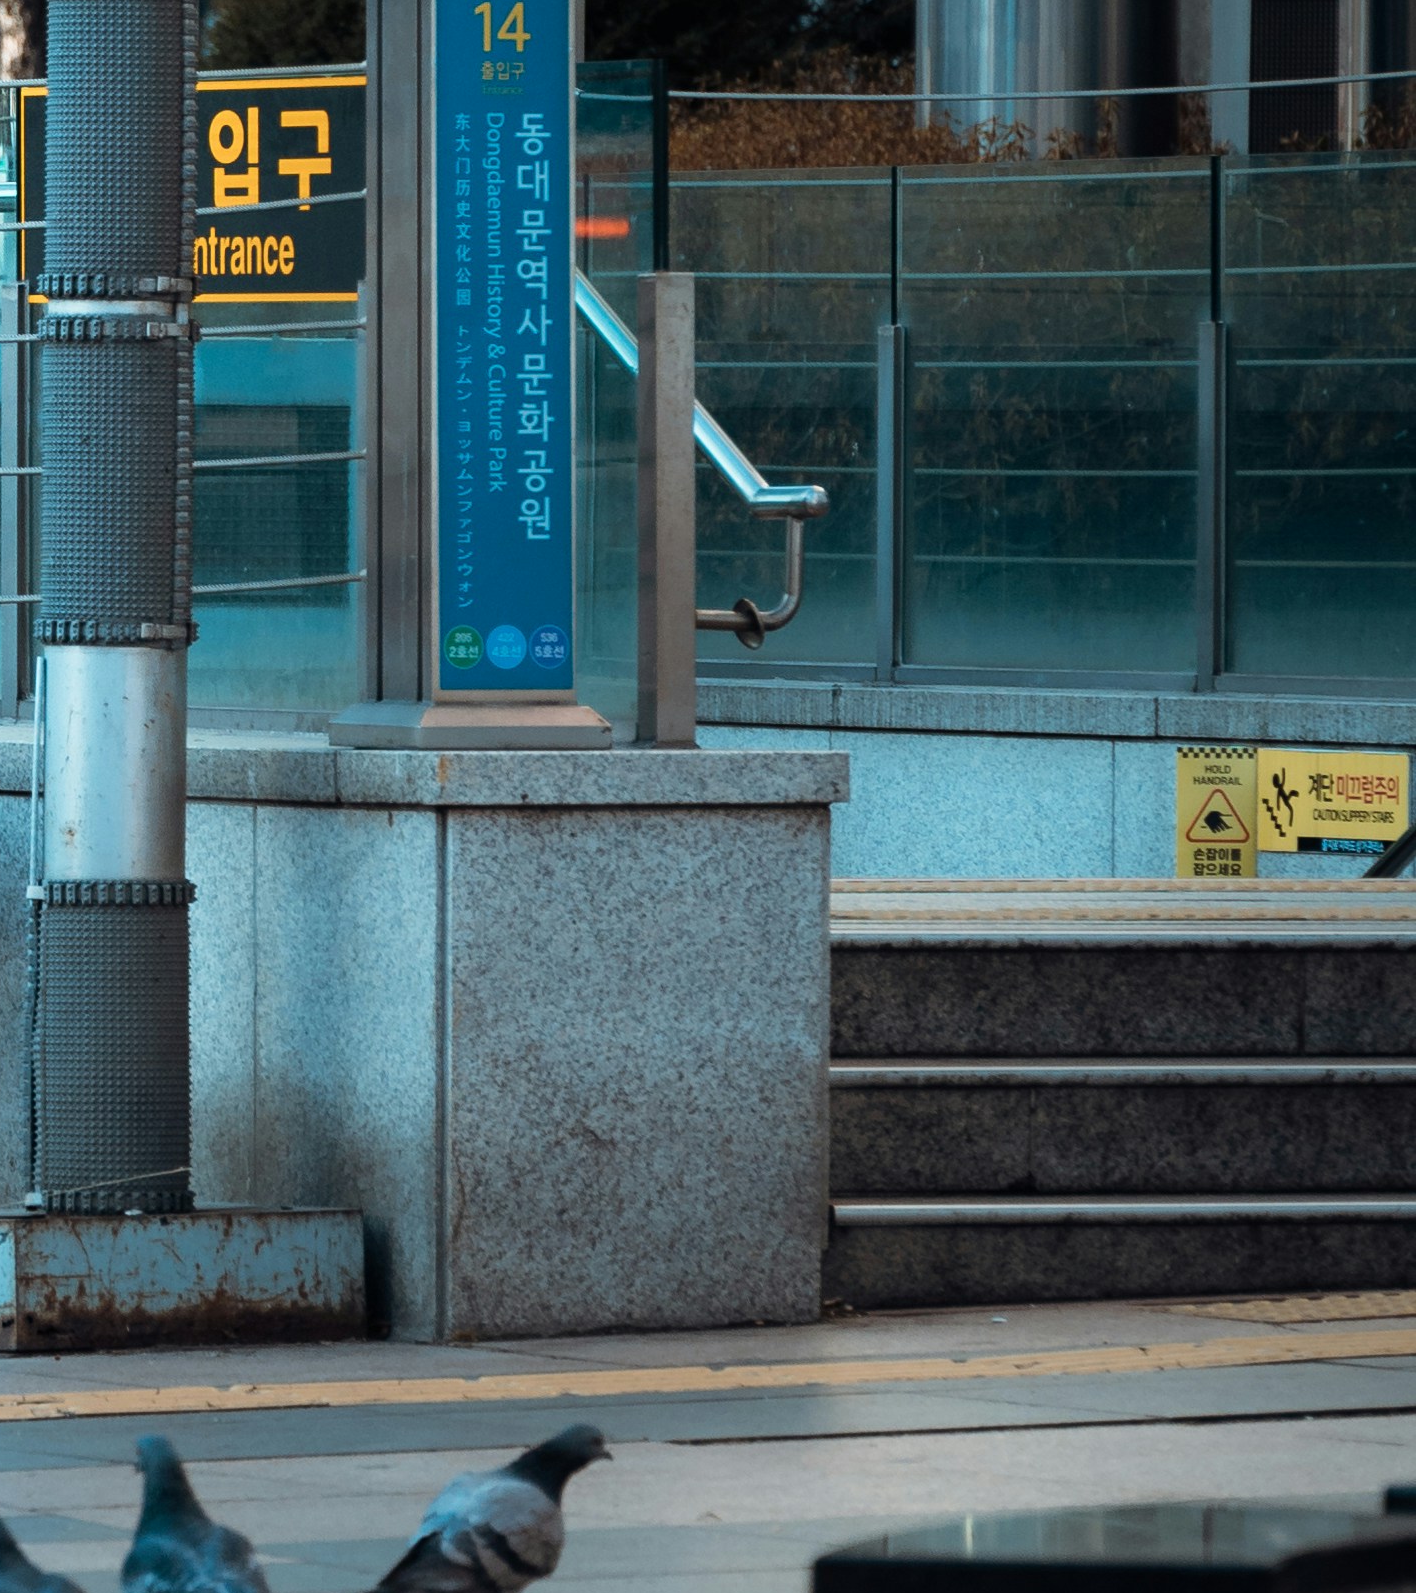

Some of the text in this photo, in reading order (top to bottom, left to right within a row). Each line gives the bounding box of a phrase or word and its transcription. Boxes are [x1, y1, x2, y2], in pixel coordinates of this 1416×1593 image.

[473, 0, 532, 53] 14
[480, 60, 525, 81] 출입구
[454, 112, 472, 307] 东大门历史文化公园
[192, 226, 295, 277] ntrance
[481, 111, 508, 493] Dongdaemun History & Culture Park
[515, 112, 555, 541] 동대문역사문화공원
[449, 645, 479, 659] 2호선
[491, 645, 522, 658] 4호선
[534, 645, 565, 660] 5호선
[1204, 765, 1232, 775] HOLD
[1193, 775, 1243, 786] HANDRAIL
[1336, 773, 1400, 805] 미끄럼주의
[1193, 848, 1242, 862] 손잡이를
[1193, 863, 1243, 877] 잡으세요
